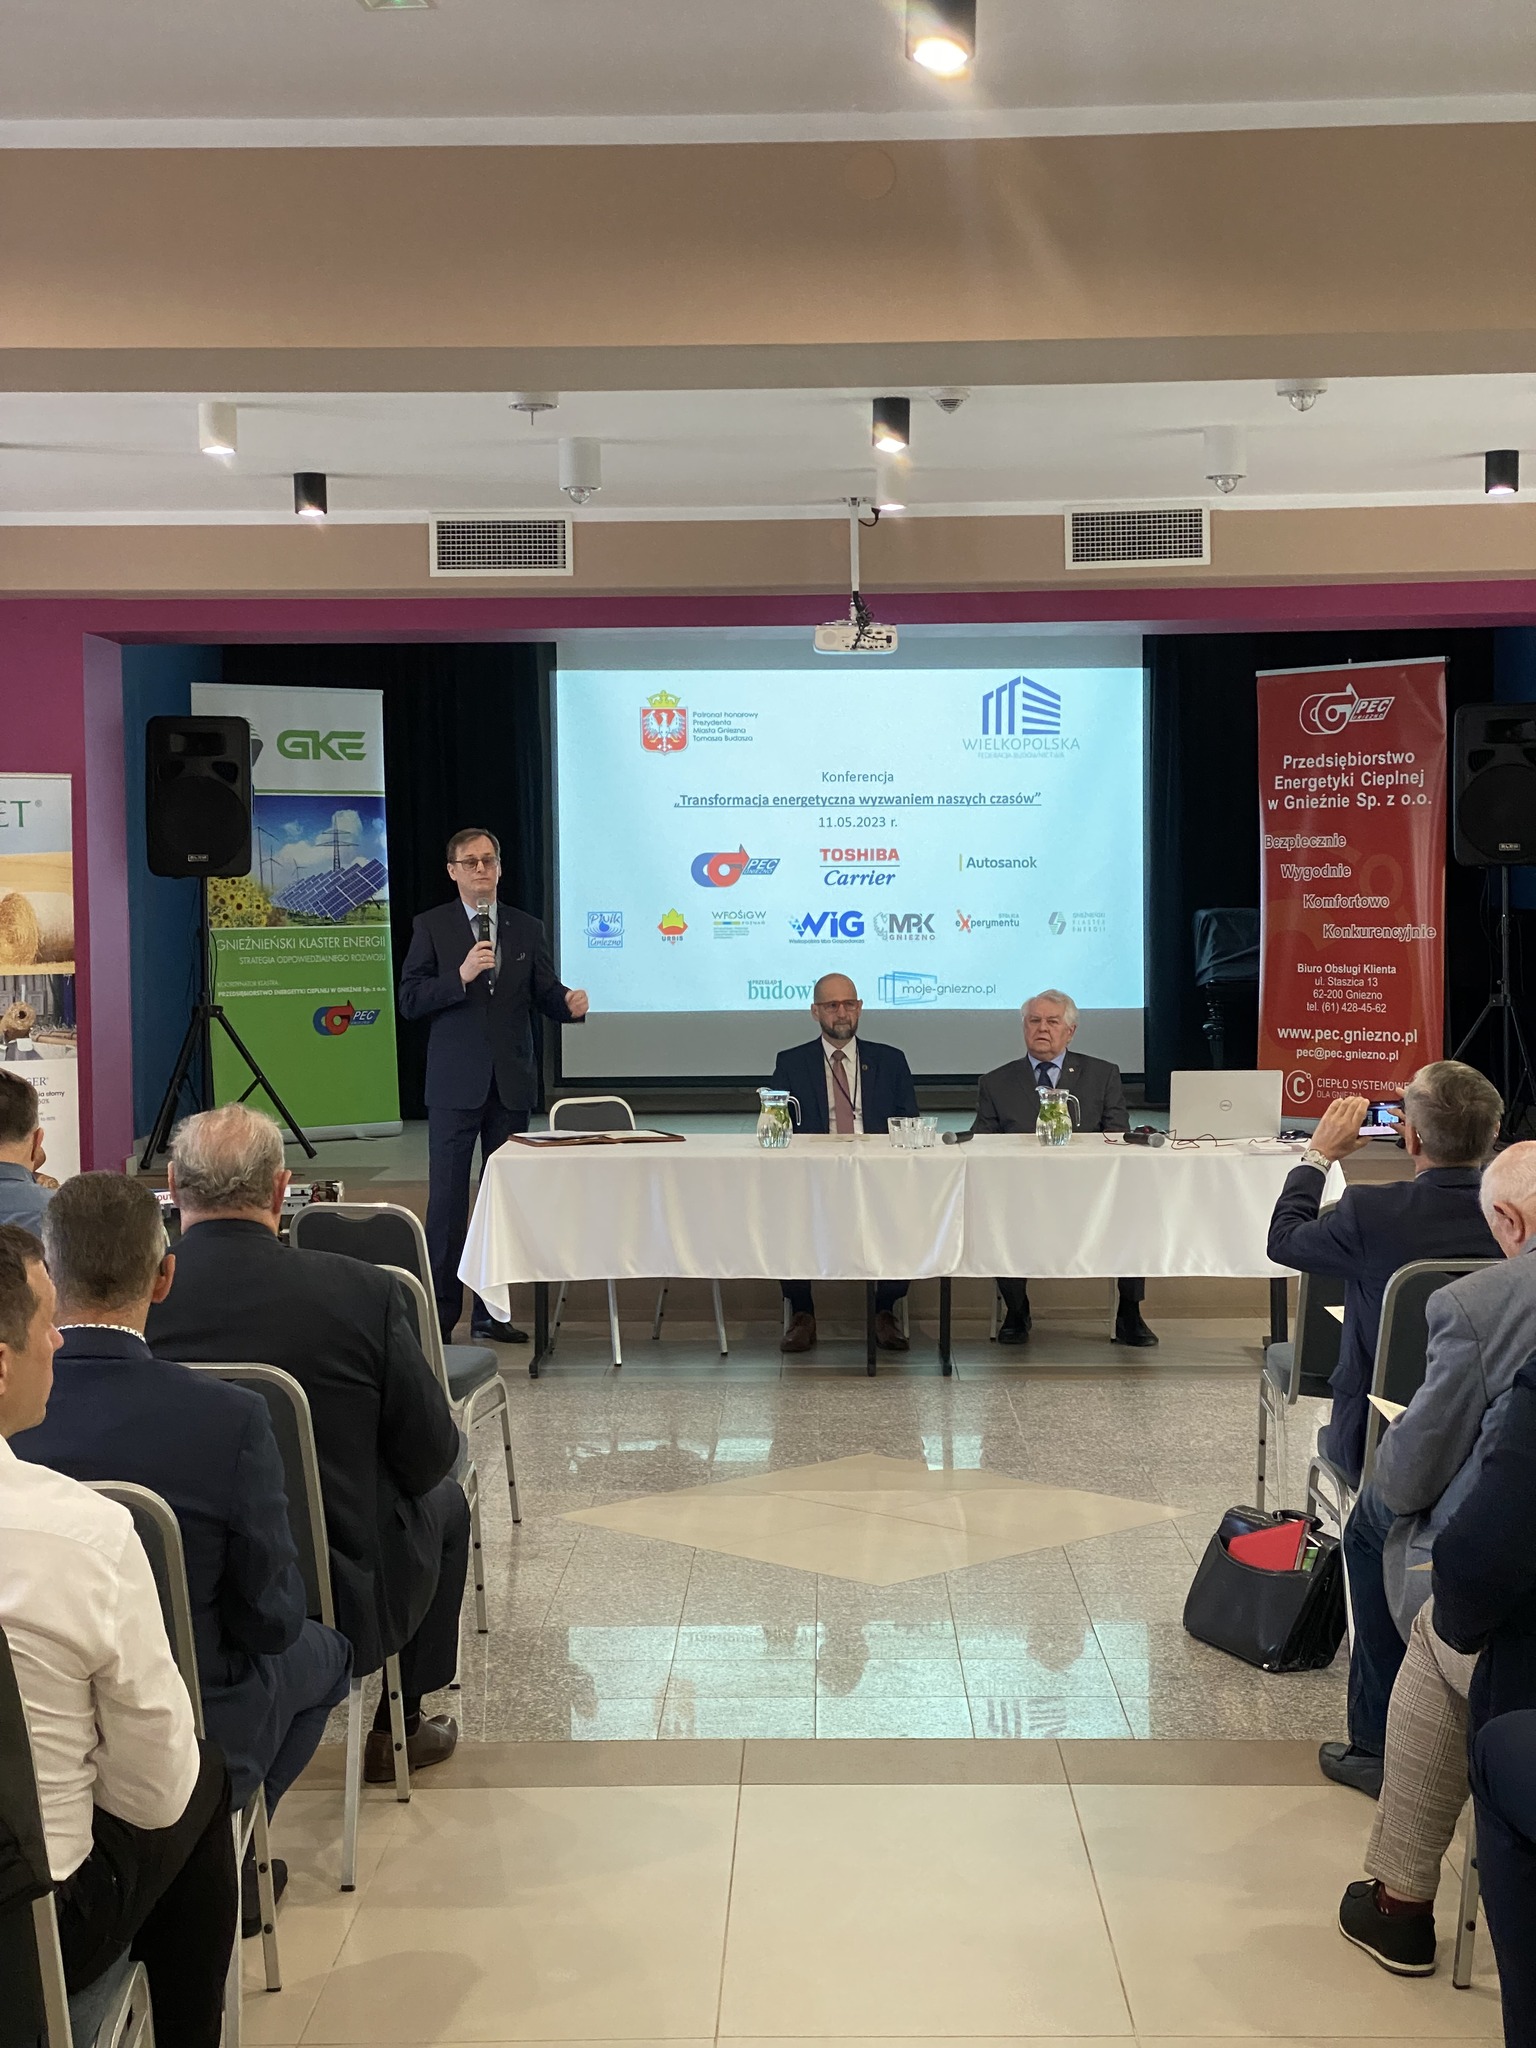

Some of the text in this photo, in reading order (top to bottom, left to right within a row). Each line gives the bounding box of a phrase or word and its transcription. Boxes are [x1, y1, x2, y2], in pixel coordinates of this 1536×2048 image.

[1356, 700, 1390, 714] PEC
[277, 730, 367, 760] GKE
[962, 738, 1080, 750] WIELKOPOLSKA
[1283, 751, 1416, 770] Przedsiębiorstwo
[822, 771, 894, 784] Konferencja
[1274, 769, 1424, 792] Energetyki Cieplnej
[772, 796, 856, 808] energetyczna
[859, 794, 934, 806] wyzwaniem
[938, 793, 986, 806] naszych
[1268, 792, 1432, 810] w Gnieźnie Sp. z o.o.
[818, 816, 898, 828] 11.05.2023 r.
[1264, 833, 1346, 851] Bezpiecznie
[820, 848, 900, 862] TOSHIBA
[966, 856, 1037, 868] Autosanok
[748, 859, 778, 870] PEC
[824, 870, 896, 886] Carrier
[1280, 864, 1352, 882] Wygodnie
[1303, 894, 1390, 908] Komfortowo
[888, 913, 936, 934] MPK
[1323, 924, 1436, 942] Konkurencyjnie
[216, 936, 386, 951] GNIEŹNIEŃSKI KLASTER ENERGII
[240, 954, 386, 965] STRATEGIA ODPOWIEDZIALNEGO ROZWOJU
[1297, 963, 1396, 976] Biuro Obsługi Klienta
[1314, 976, 1378, 986] ul. Staszica 13
[902, 983, 996, 996] moje-gniezno.pl
[1312, 990, 1382, 1000] 62-200 Gniezno
[352, 1010, 375, 1020] PEC
[1306, 1002, 1386, 1014] tel. (61) 428-45-62
[1277, 1027, 1418, 1046] www.pec.gniezno.pl
[1296, 1047, 1399, 1062] pec@pec.gniezno.pl
[1316, 1078, 1349, 1089] CIEPŁO
[1316, 1090, 1330, 1098] DLA
